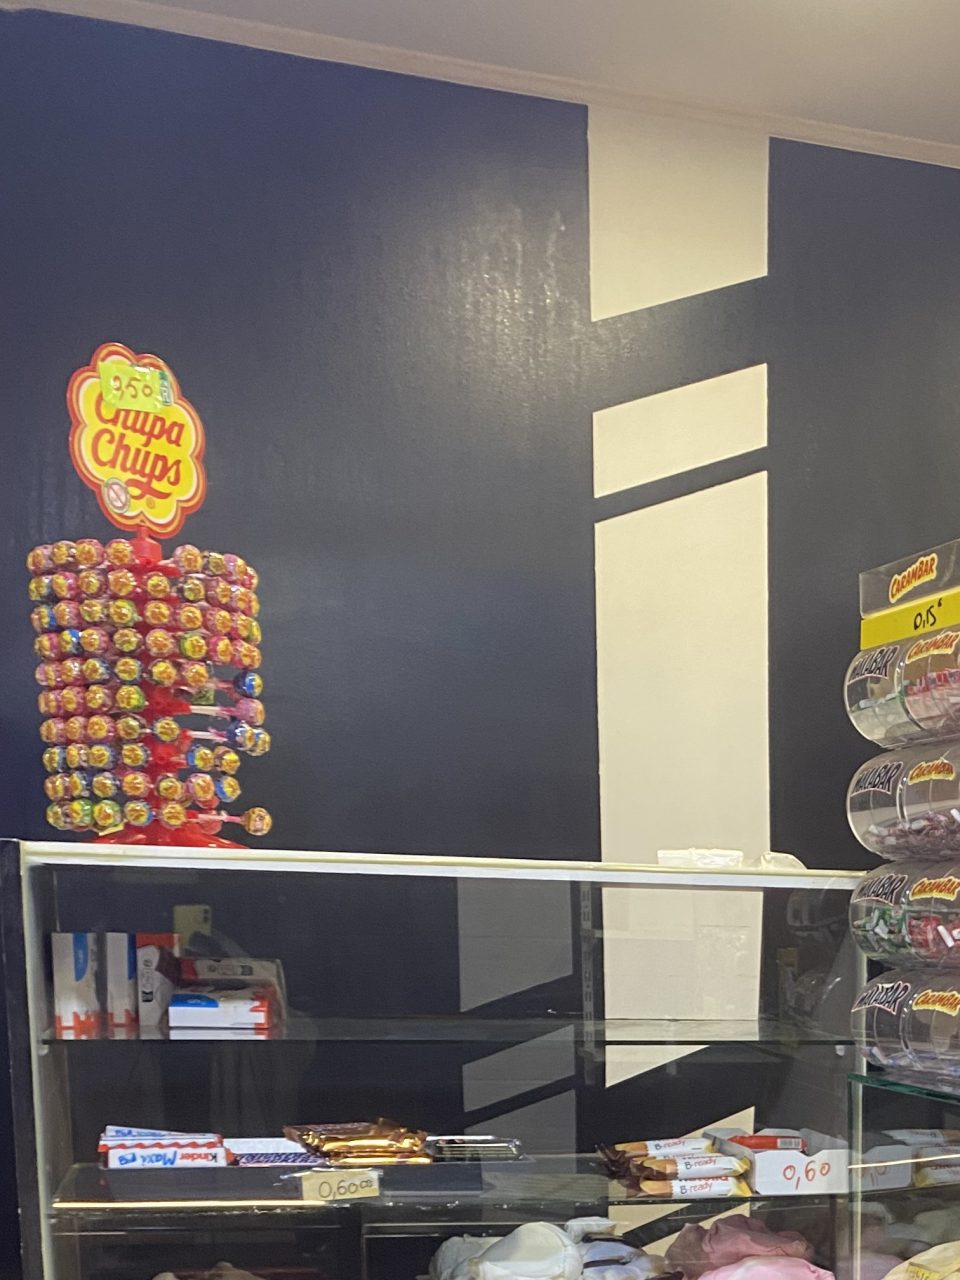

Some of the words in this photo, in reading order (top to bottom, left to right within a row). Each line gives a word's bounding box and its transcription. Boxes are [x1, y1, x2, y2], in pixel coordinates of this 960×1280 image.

[92, 428, 182, 499] Chups
[888, 554, 938, 602] CARAMBAR
[680, 1181, 714, 1195] B-ready
[781, 1160, 832, 1190] 0,60
